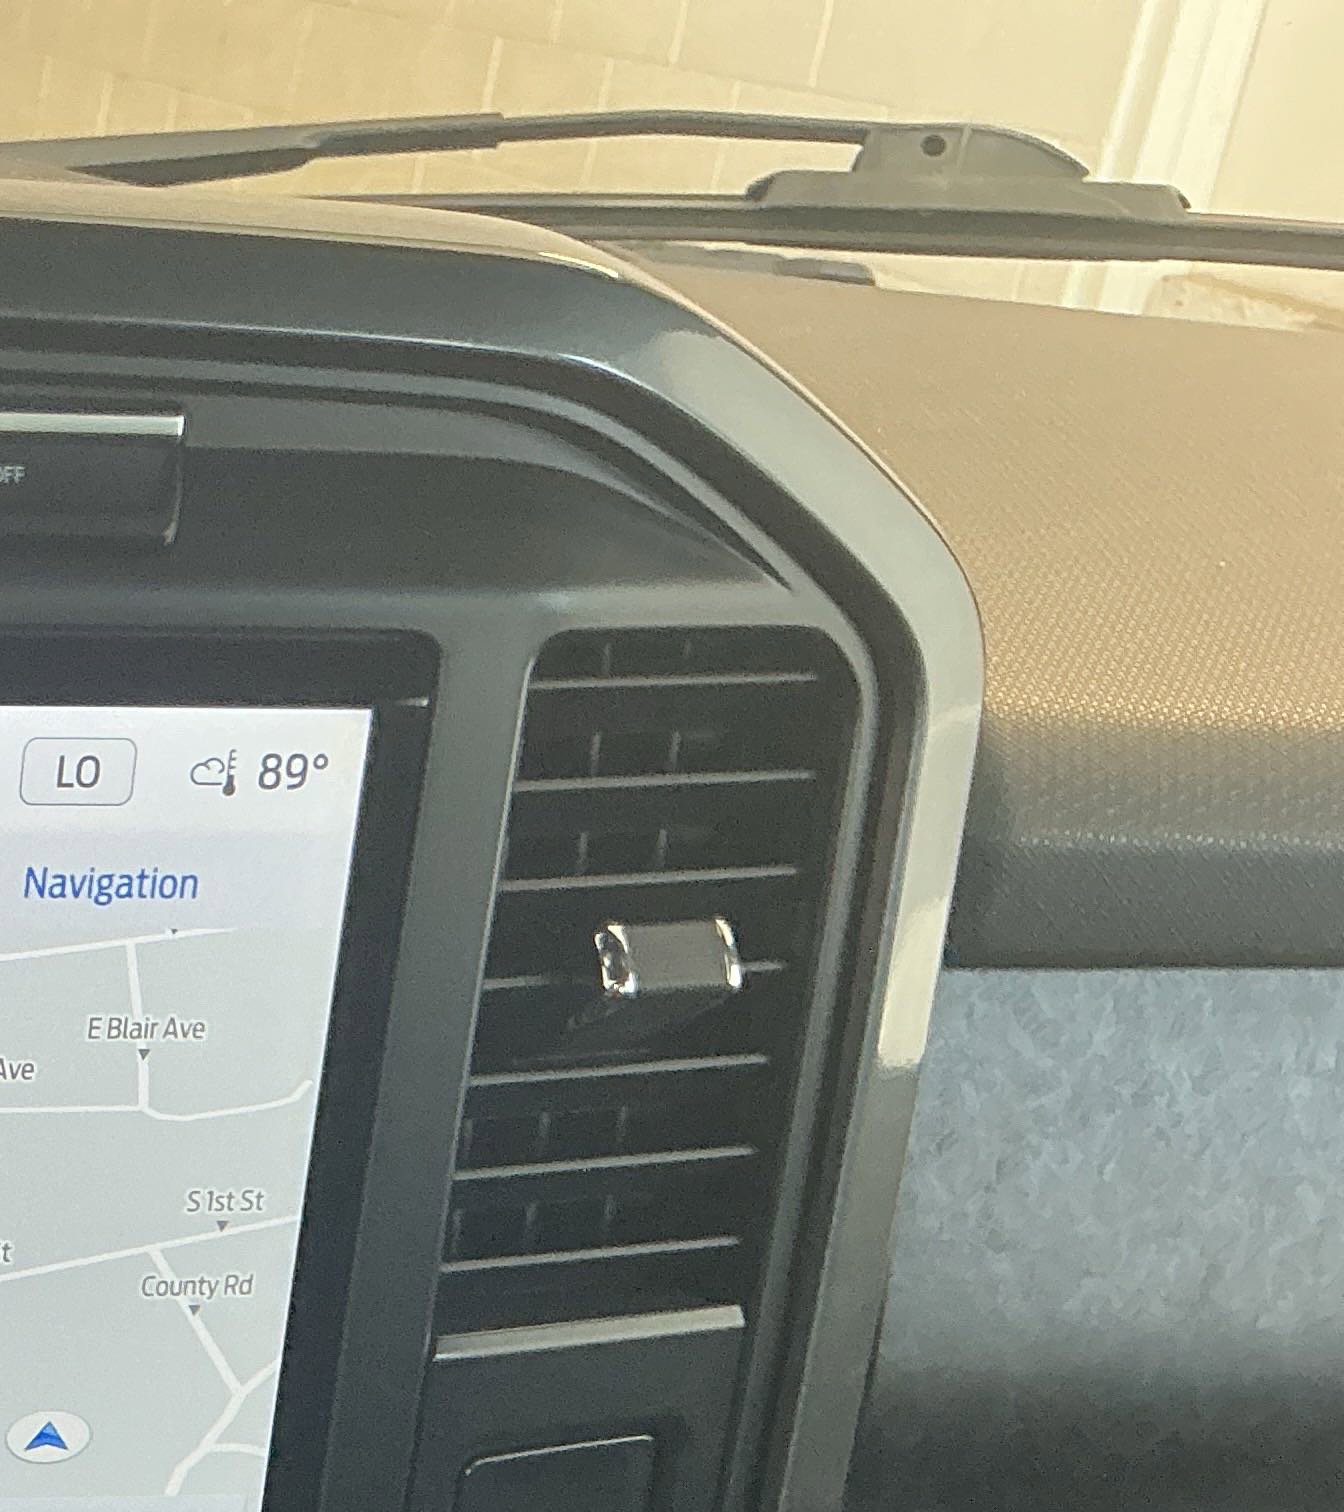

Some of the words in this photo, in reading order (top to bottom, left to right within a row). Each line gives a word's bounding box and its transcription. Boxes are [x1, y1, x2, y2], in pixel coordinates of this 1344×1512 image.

[56, 755, 101, 789] LO
[258, 753, 329, 790] 89°
[23, 866, 199, 906] Navigation
[88, 1018, 102, 1040] E
[107, 1018, 159, 1040] Blair
[162, 1017, 206, 1040] Ave
[186, 1191, 202, 1212] S
[205, 1190, 234, 1212] 1st
[238, 1190, 265, 1212] St
[141, 1276, 219, 1301] County
[223, 1274, 254, 1296] Rd
